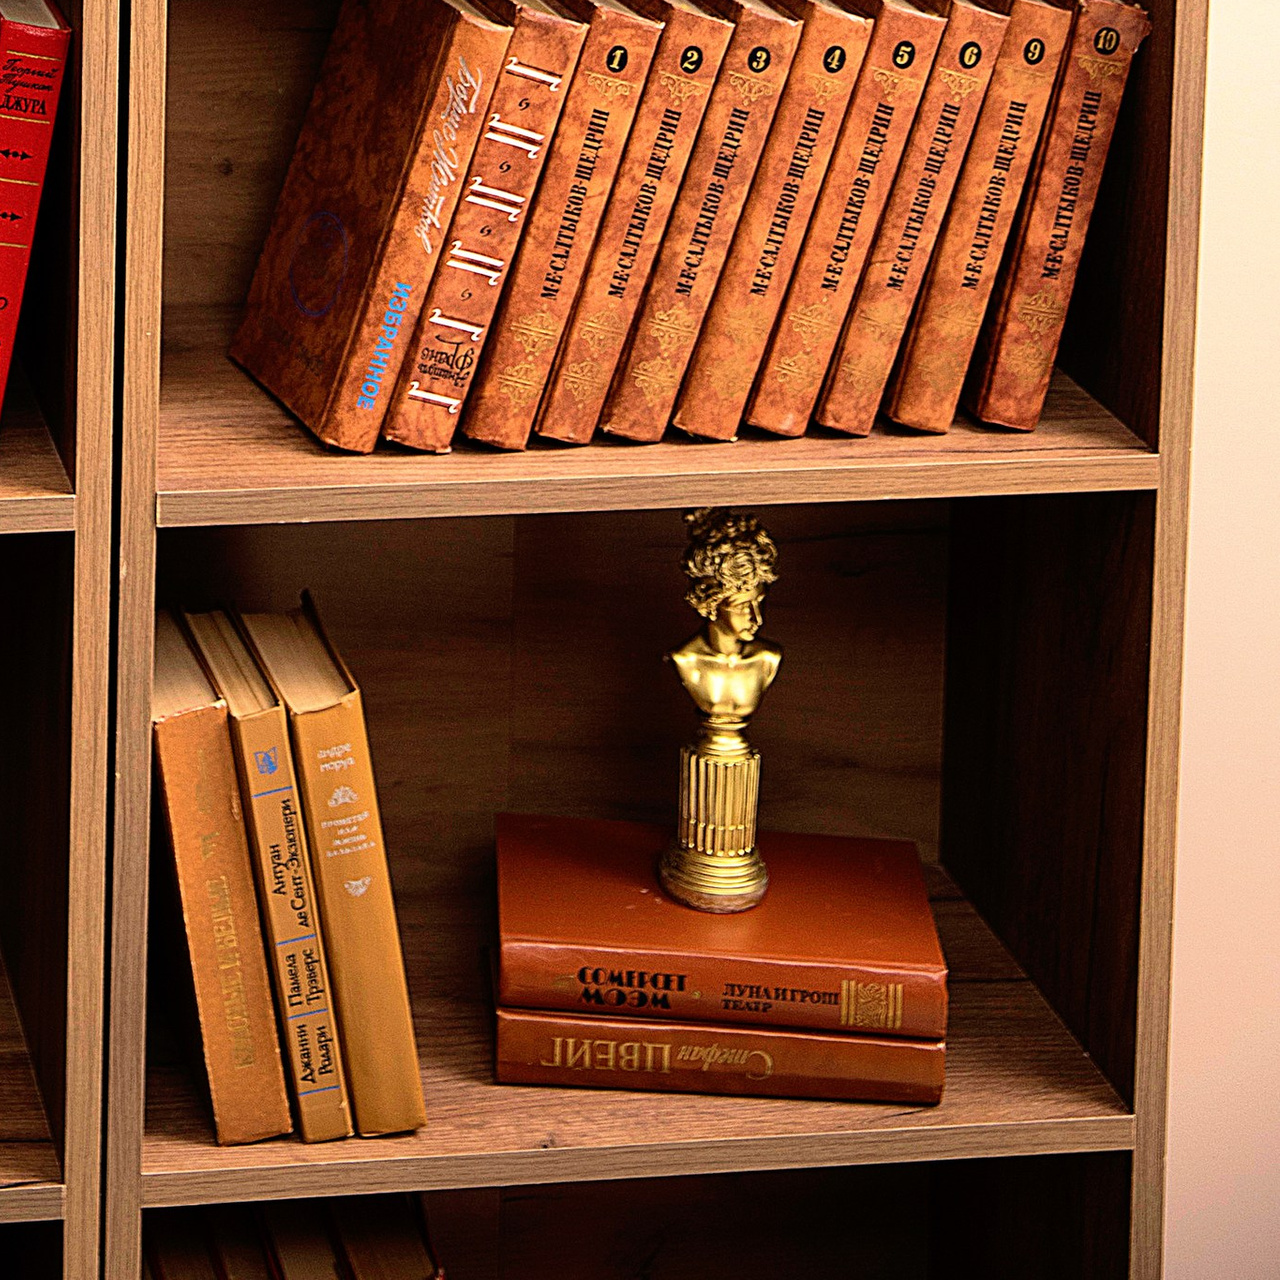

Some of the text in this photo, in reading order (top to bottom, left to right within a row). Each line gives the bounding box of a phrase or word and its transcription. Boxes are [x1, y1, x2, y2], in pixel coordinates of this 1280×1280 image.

[1028, 41, 1041, 60] 9
[1097, 30, 1117, 51] 10
[896, 46, 913, 65] 5
[963, 46, 977, 65] 6
[0, 94, 47, 115] ДЖУРА
[356, 281, 413, 411] ИЗБРАННОЕ
[283, 798, 309, 912] Сент-Экзюпери
[271, 843, 288, 896] Антуан
[288, 953, 304, 1007] Памела
[304, 948, 321, 1006] Трэверс
[577, 966, 687, 991] СОМЕРСЕТ
[580, 987, 671, 1009] МОЭМ
[722, 982, 771, 999] ЛУНА
[788, 989, 839, 1005] ГРОШ
[722, 999, 773, 1013] ТЕАТР
[299, 1023, 315, 1085] Джанни
[318, 1024, 335, 1076] Родари
[540, 1037, 774, 1080] Стефан ЦВЕЙГ
